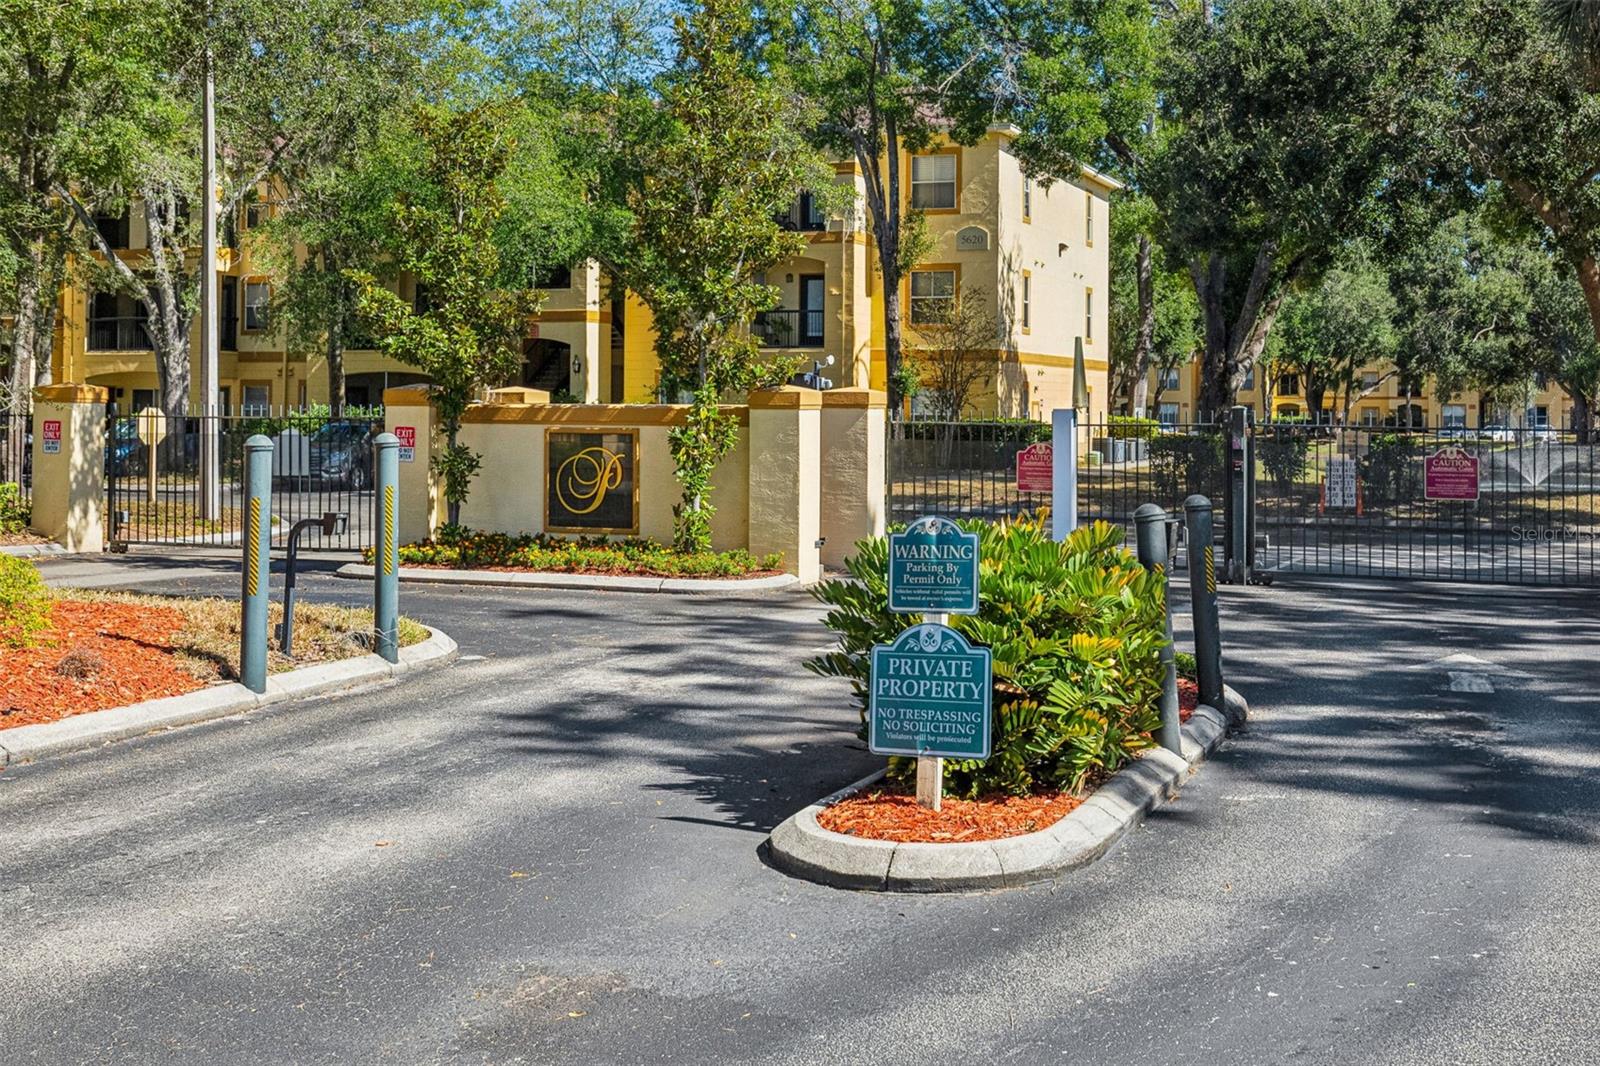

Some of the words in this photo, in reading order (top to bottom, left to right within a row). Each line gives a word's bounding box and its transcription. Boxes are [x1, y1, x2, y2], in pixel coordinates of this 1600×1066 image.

[960, 235, 984, 245] 5620
[45, 423, 59, 431] EXIT
[396, 429, 413, 437] EXIT
[44, 431, 60, 439] ONLY
[400, 437, 414, 446] NLY
[1432, 459, 1472, 467] CAUTION
[894, 544, 973, 559] WARNING
[906, 562, 943, 575] Parking
[946, 562, 960, 575] By
[903, 574, 935, 584] Permit
[937, 574, 962, 587] Only
[888, 657, 973, 678] PRIVATE
[877, 678, 983, 699] PROPERTY
[878, 707, 896, 718] NO
[898, 708, 981, 723] TRESPASSING
[882, 719, 900, 731] NO
[903, 720, 976, 735] SOLICITING
[886, 732, 912, 740] Violators
[914, 733, 926, 741] will
[927, 734, 936, 742] be
[936, 735, 972, 744] prosecuted
